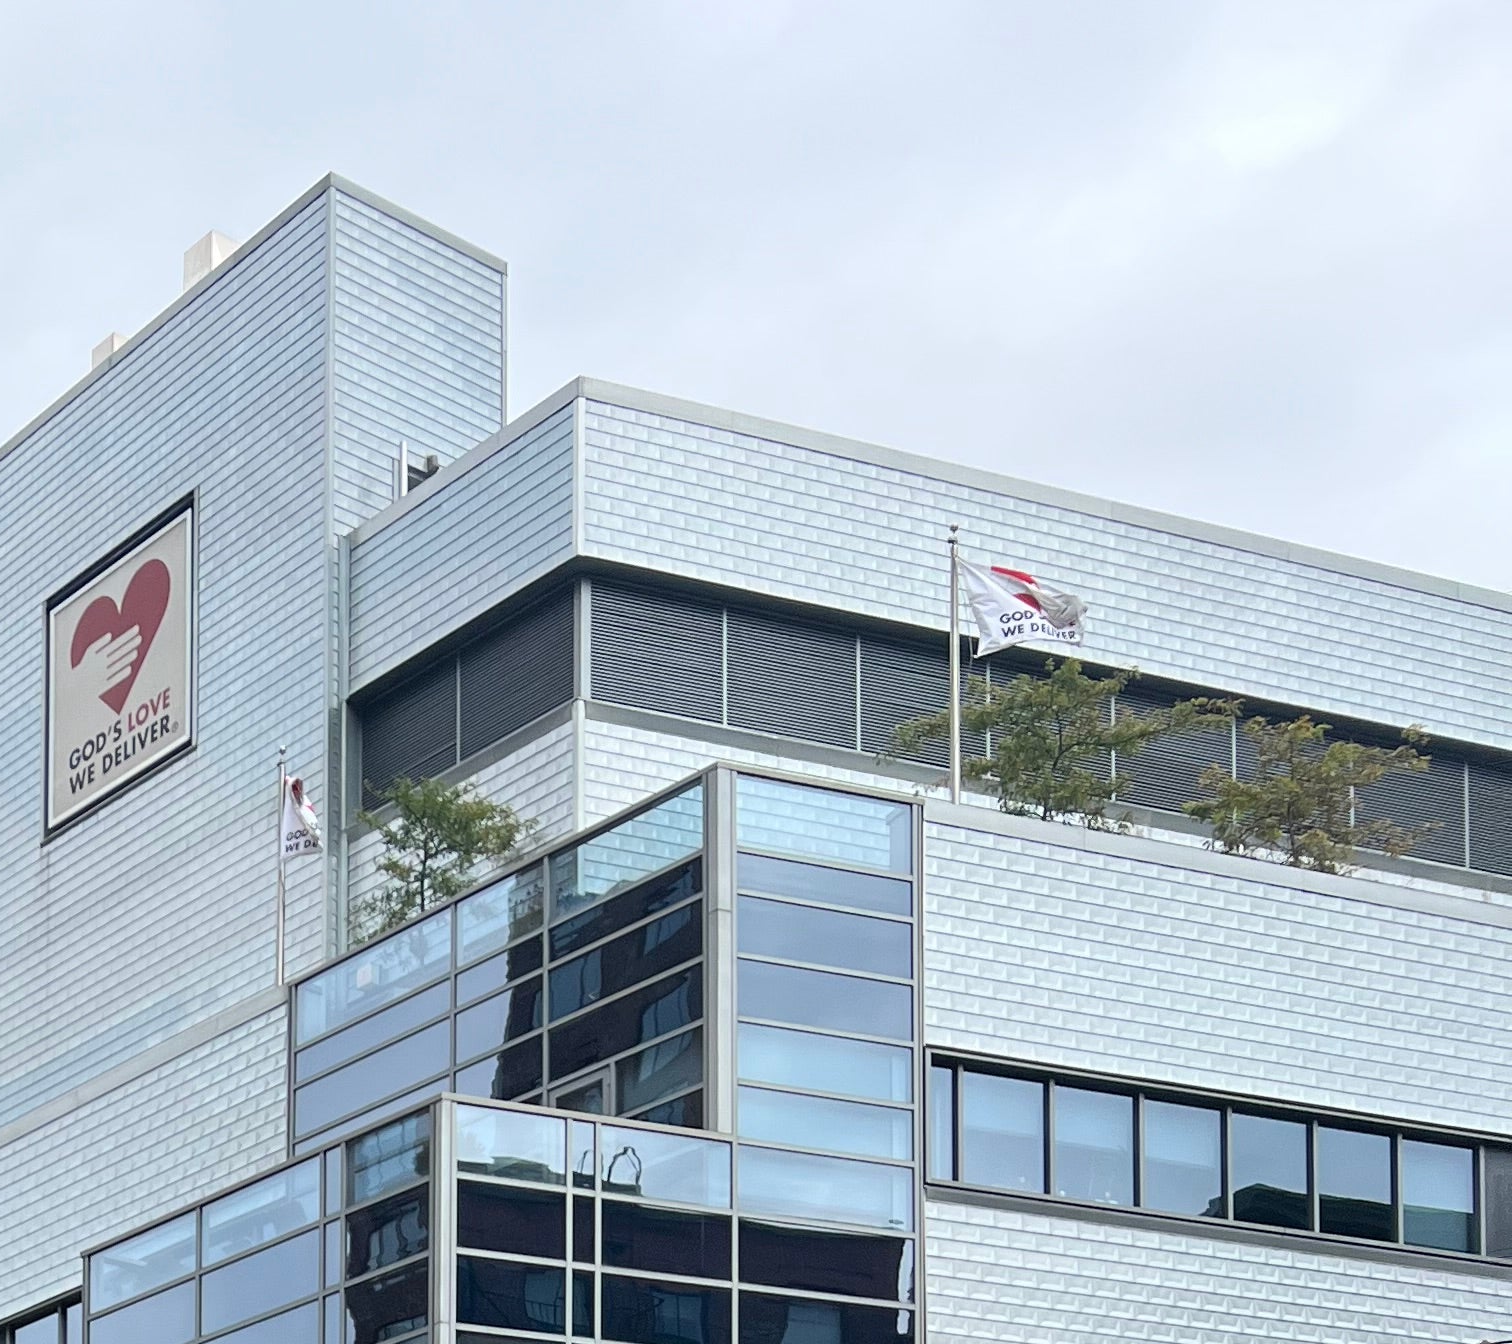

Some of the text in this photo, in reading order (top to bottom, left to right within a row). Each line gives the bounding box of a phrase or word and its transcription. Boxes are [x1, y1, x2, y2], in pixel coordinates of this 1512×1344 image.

[999, 610, 1046, 623] GOD
[1001, 622, 1076, 640] WE DELIVER
[69, 687, 170, 770] GOD'S LOVE
[69, 714, 170, 794] WE DELIVER
